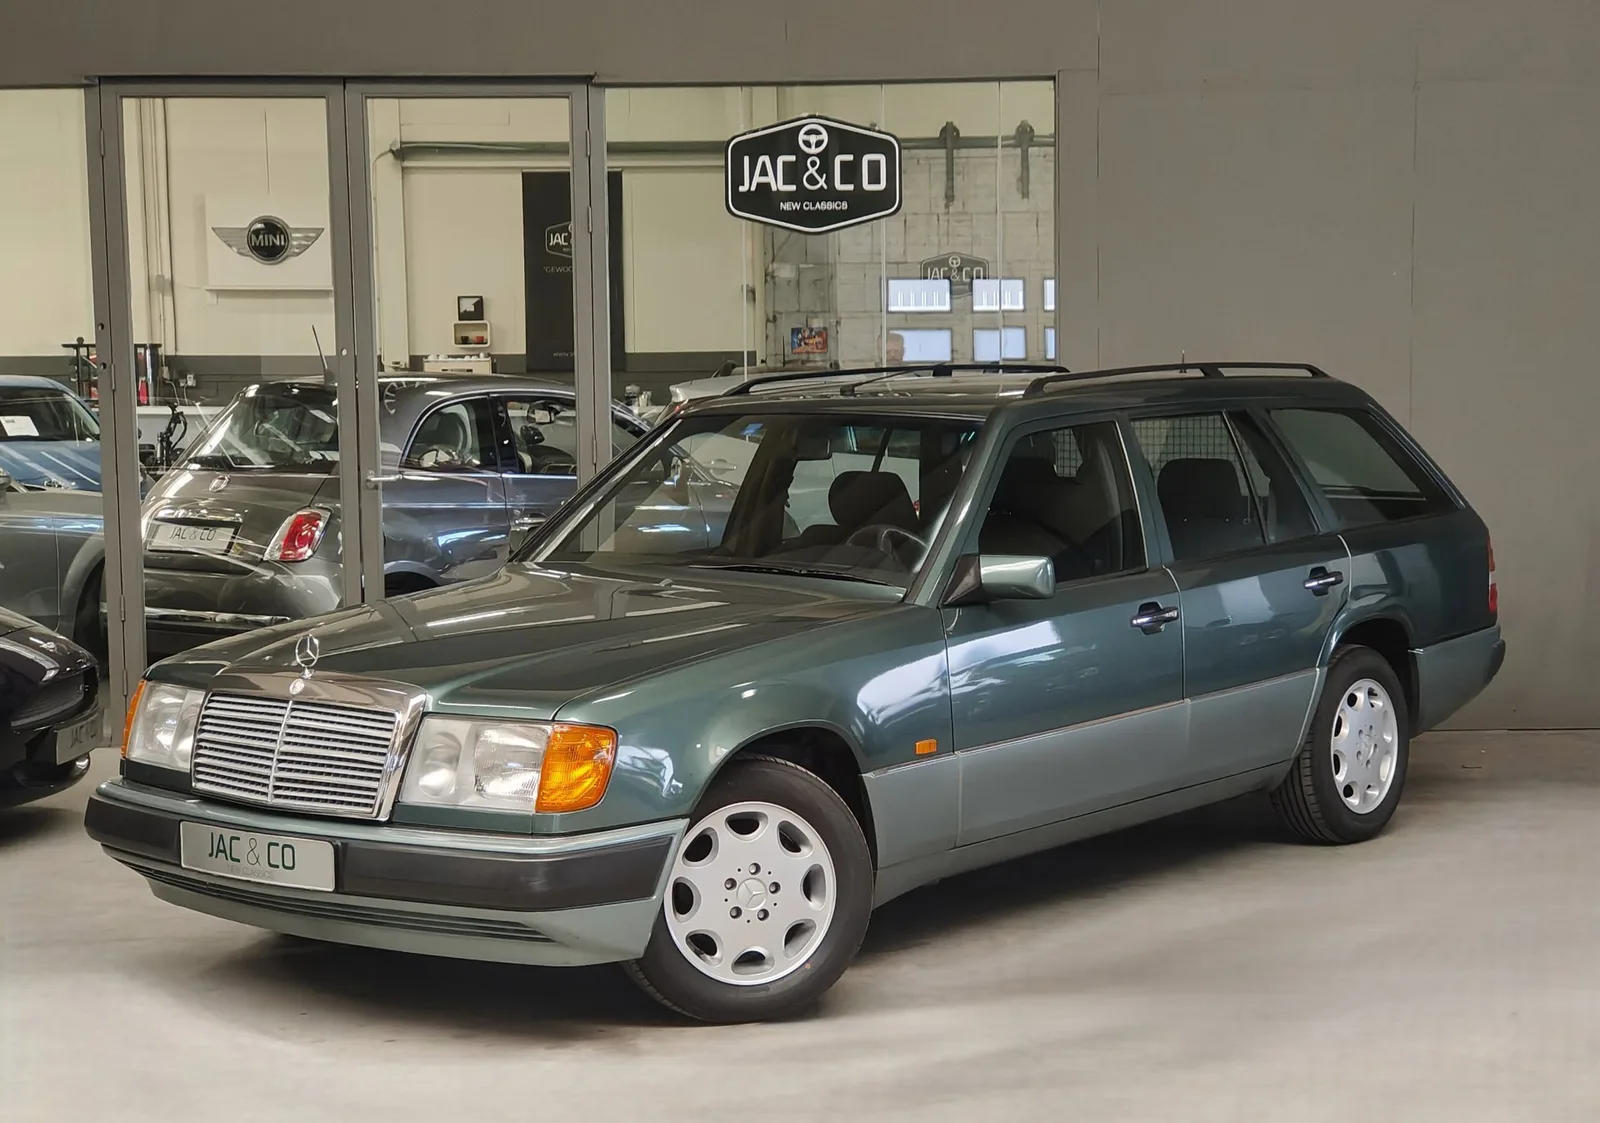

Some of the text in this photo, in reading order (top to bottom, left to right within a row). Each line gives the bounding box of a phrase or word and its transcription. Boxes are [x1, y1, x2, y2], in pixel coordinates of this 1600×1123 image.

[738, 153, 887, 193] JAC & CO
[779, 200, 849, 211] NEW CLASSICS
[251, 233, 285, 247] MINI
[549, 232, 569, 246] JAC
[208, 831, 296, 871] JAC & CO
